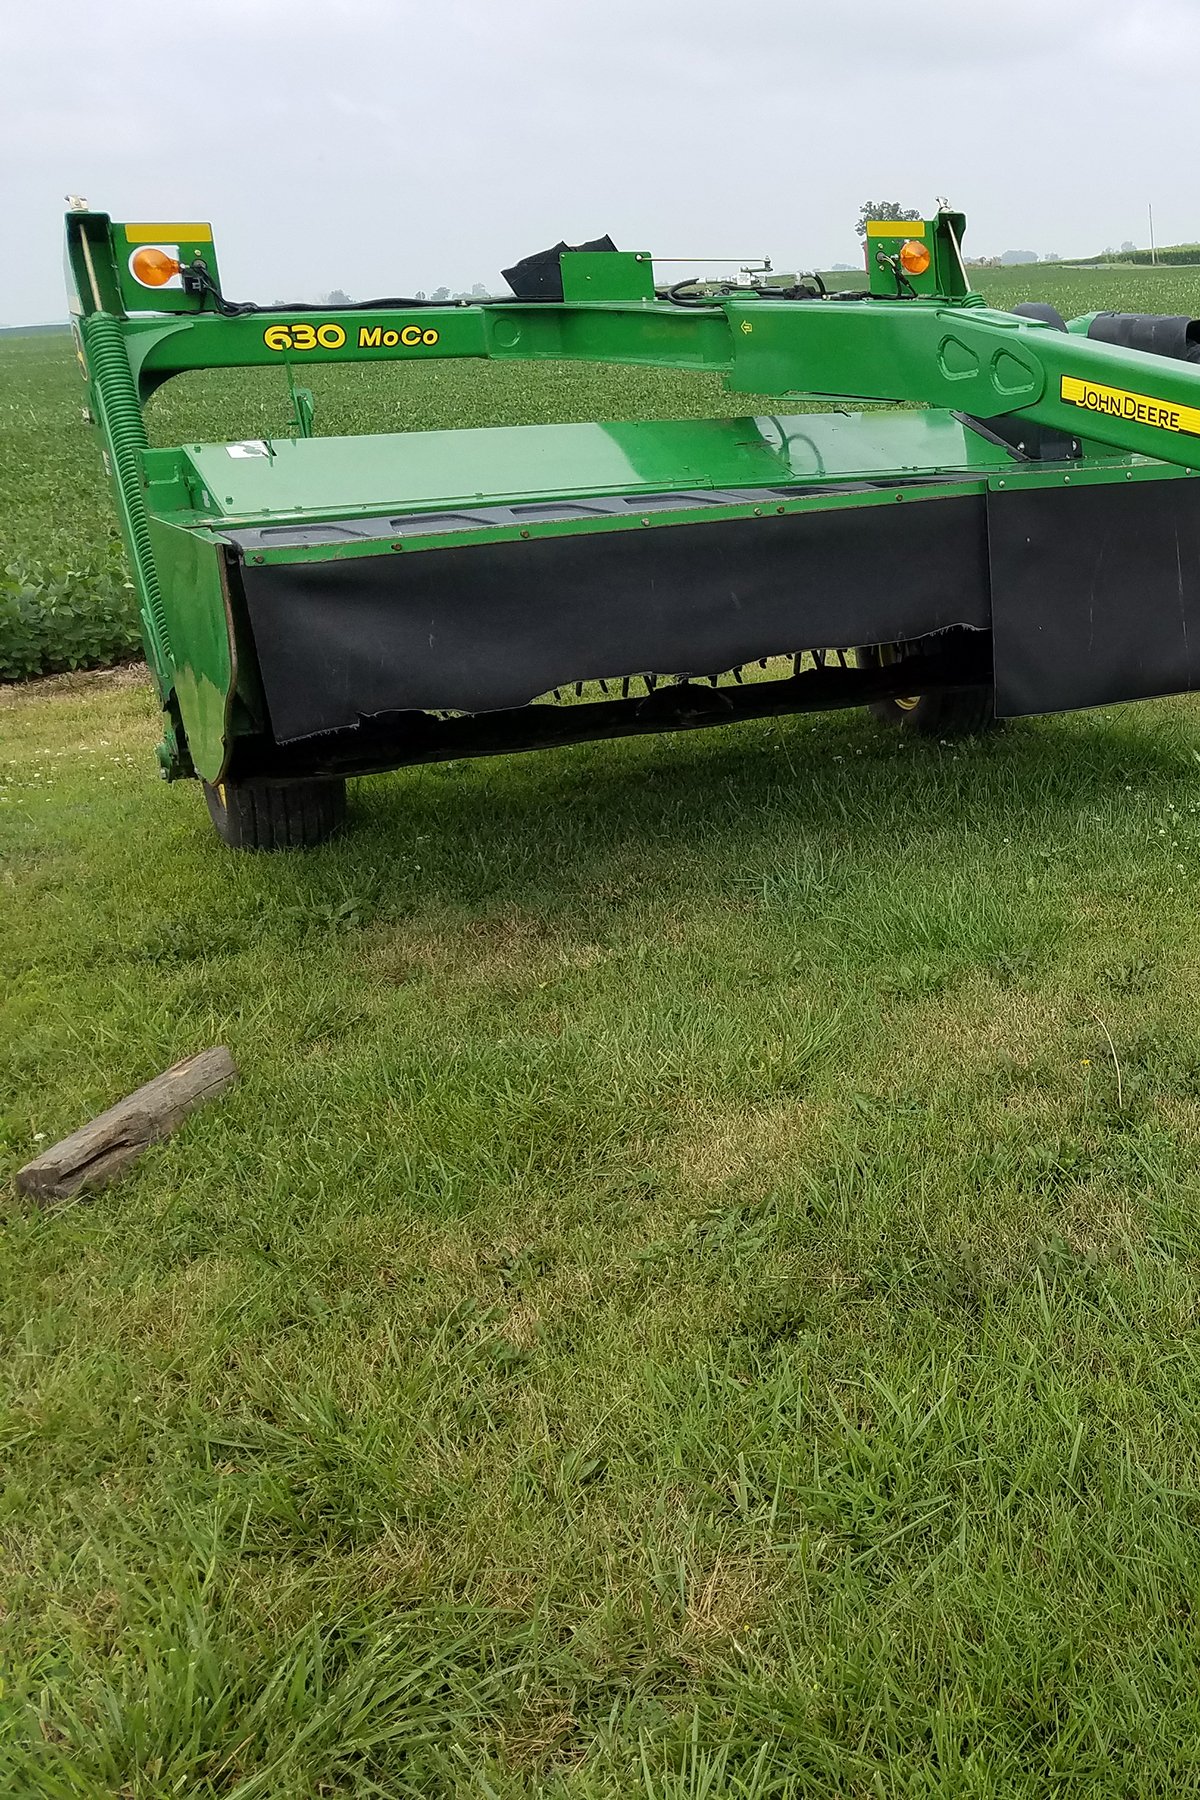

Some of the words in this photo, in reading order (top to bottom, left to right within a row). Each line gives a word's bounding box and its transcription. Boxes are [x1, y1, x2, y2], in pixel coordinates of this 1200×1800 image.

[263, 323, 347, 351] 630
[358, 325, 439, 348] MoCo
[1078, 386, 1121, 413] JOHN
[1124, 396, 1180, 429] DEERE
